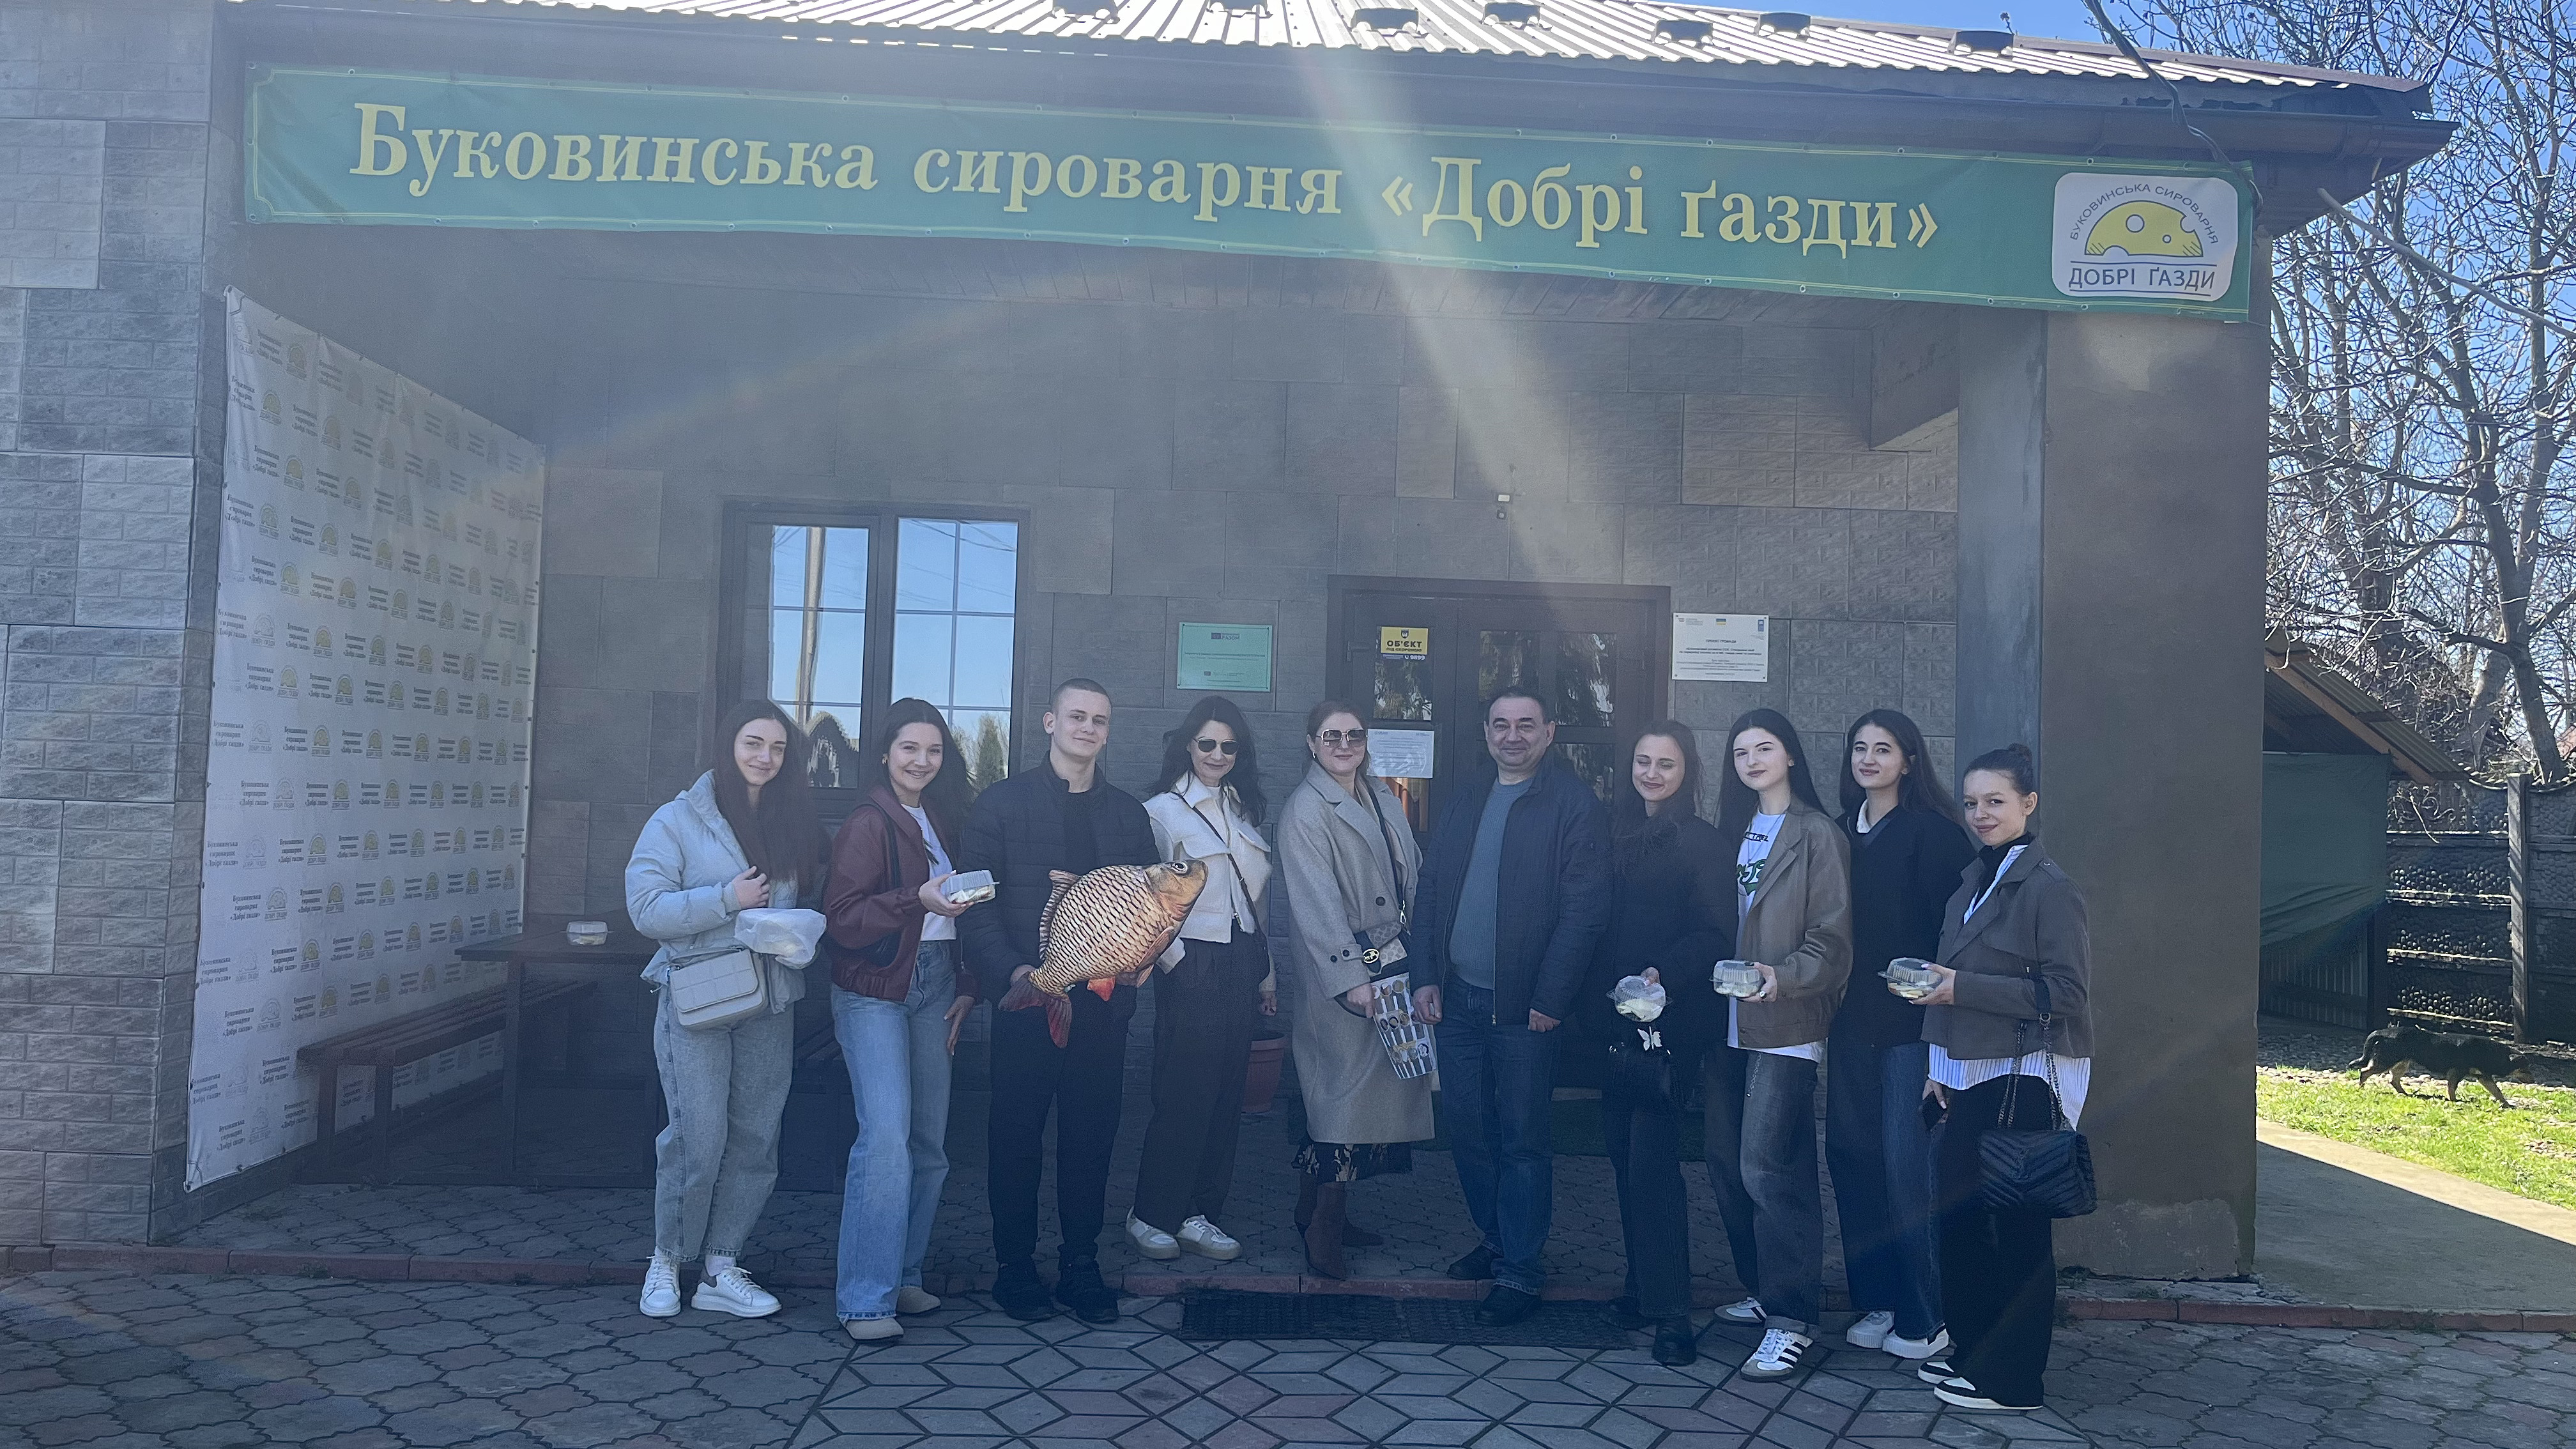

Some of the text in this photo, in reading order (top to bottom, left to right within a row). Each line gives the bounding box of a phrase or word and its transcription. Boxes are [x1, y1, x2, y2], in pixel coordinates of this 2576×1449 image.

[349, 102, 1938, 258] Буковинська сироварня «Добрі ґазди»
[2070, 183, 2219, 245] БУКОВИНСЬКА СИРОВАРНЯ
[2068, 266, 2215, 291] ДОБРІ ҐАЗДИ
